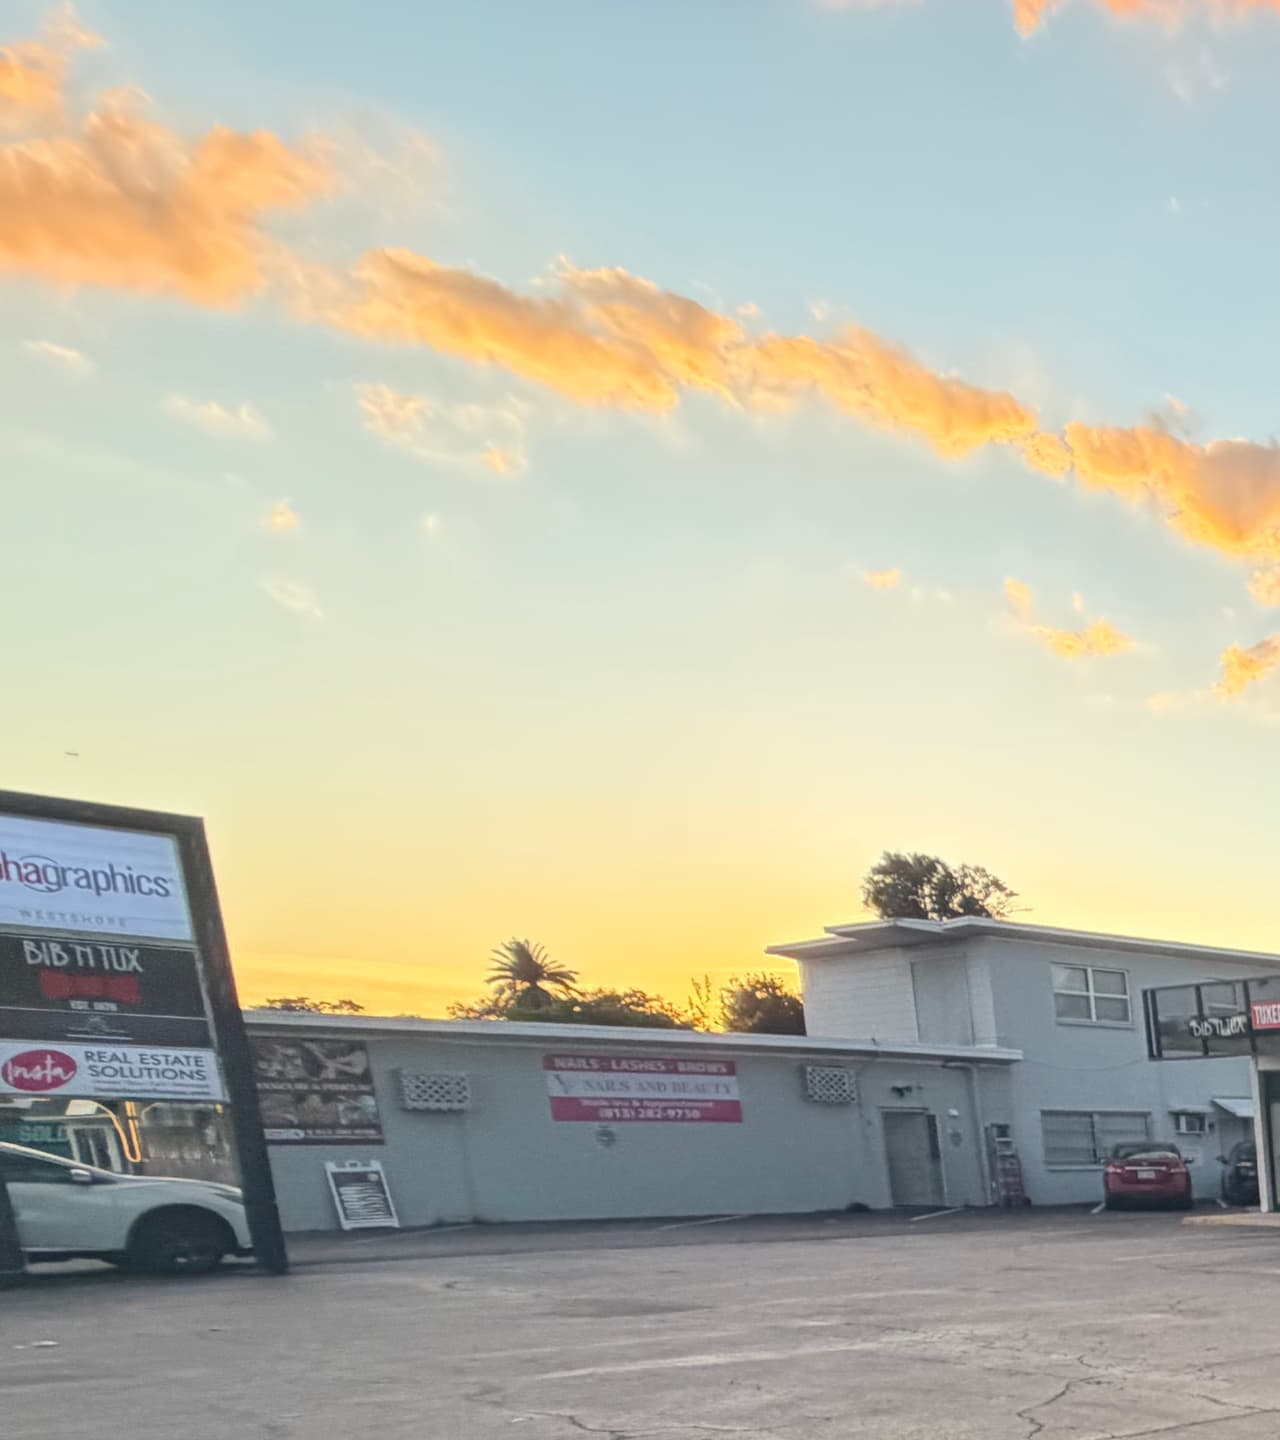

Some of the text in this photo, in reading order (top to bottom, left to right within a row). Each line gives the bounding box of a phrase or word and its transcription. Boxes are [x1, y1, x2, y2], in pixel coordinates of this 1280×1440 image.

[23, 940, 69, 967] BIB
[97, 946, 143, 973] TUX
[6, 1053, 74, 1083] Insta
[84, 1051, 205, 1068] REAL ESTATE
[89, 1065, 207, 1081] SOLUTIONS
